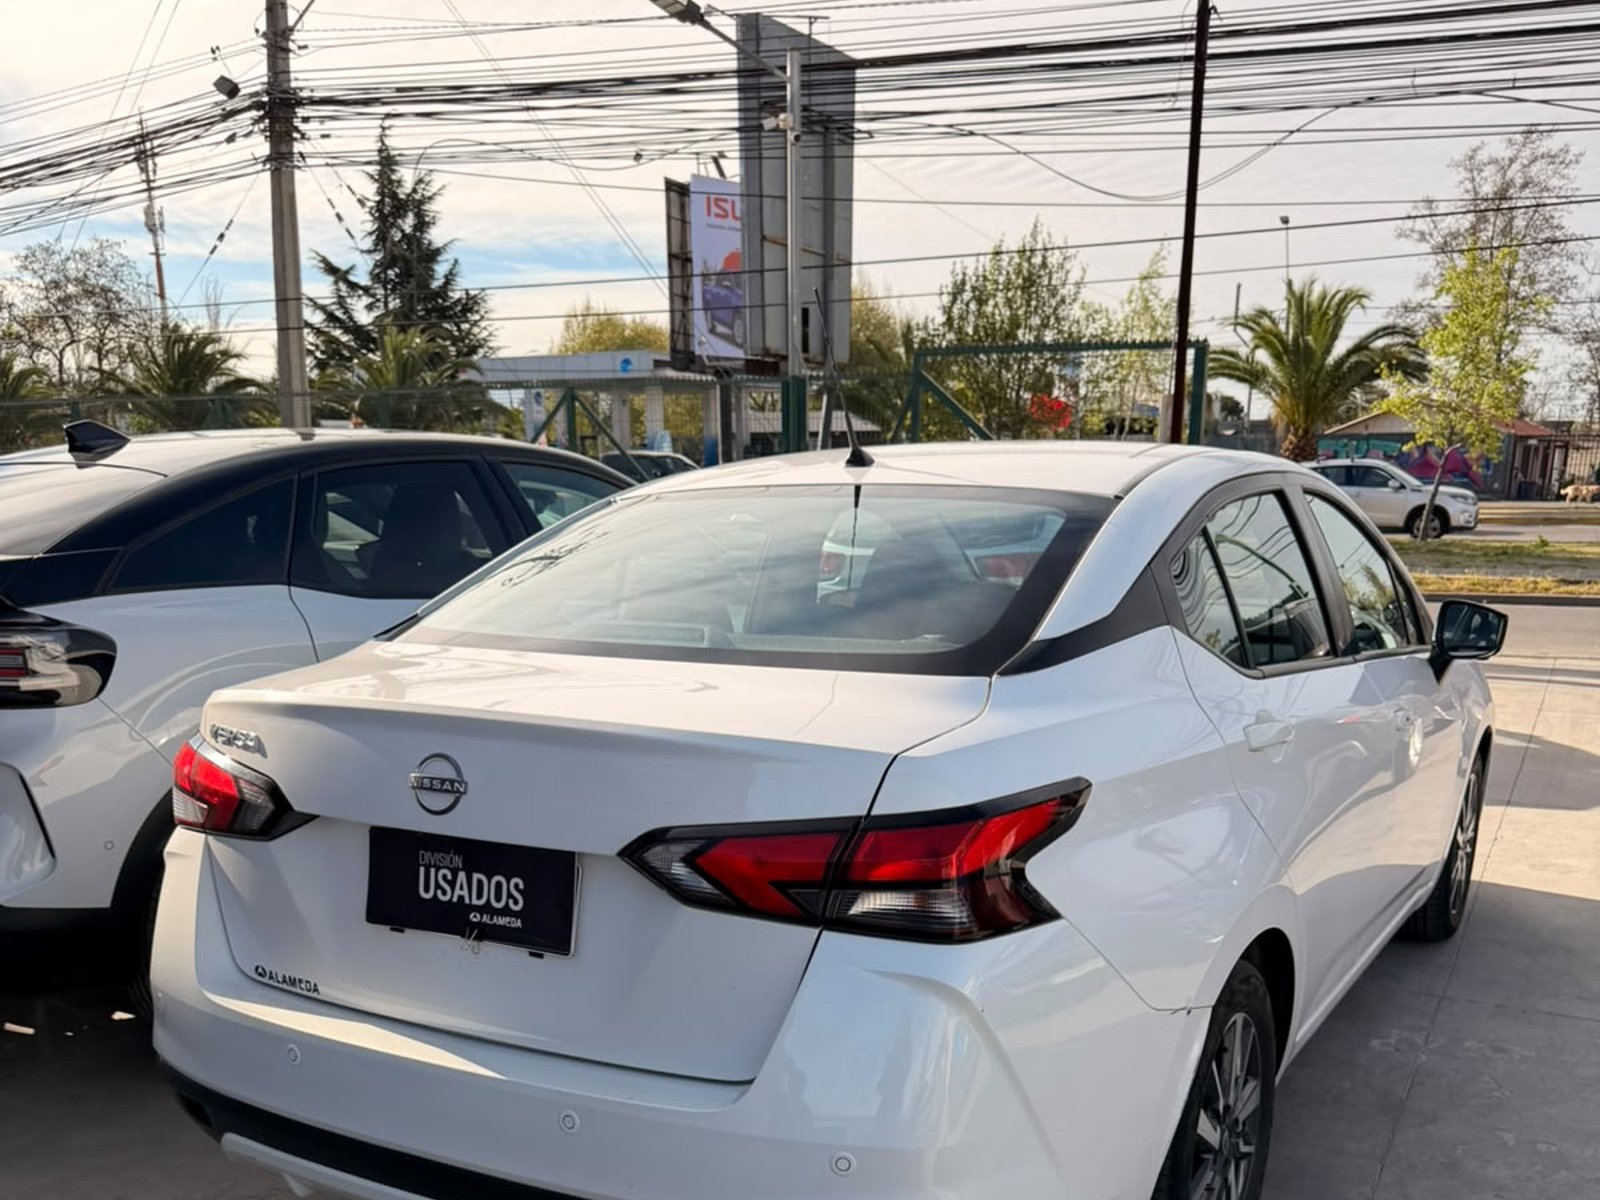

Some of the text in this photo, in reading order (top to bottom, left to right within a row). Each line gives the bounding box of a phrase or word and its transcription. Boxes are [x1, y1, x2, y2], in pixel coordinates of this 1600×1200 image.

[409, 774, 466, 793] NISSAN
[419, 849, 463, 869] DIVISIÓN
[418, 866, 525, 911] USADOS
[481, 913, 522, 928] ALAMEDA
[268, 970, 321, 995] ALAMEDA
